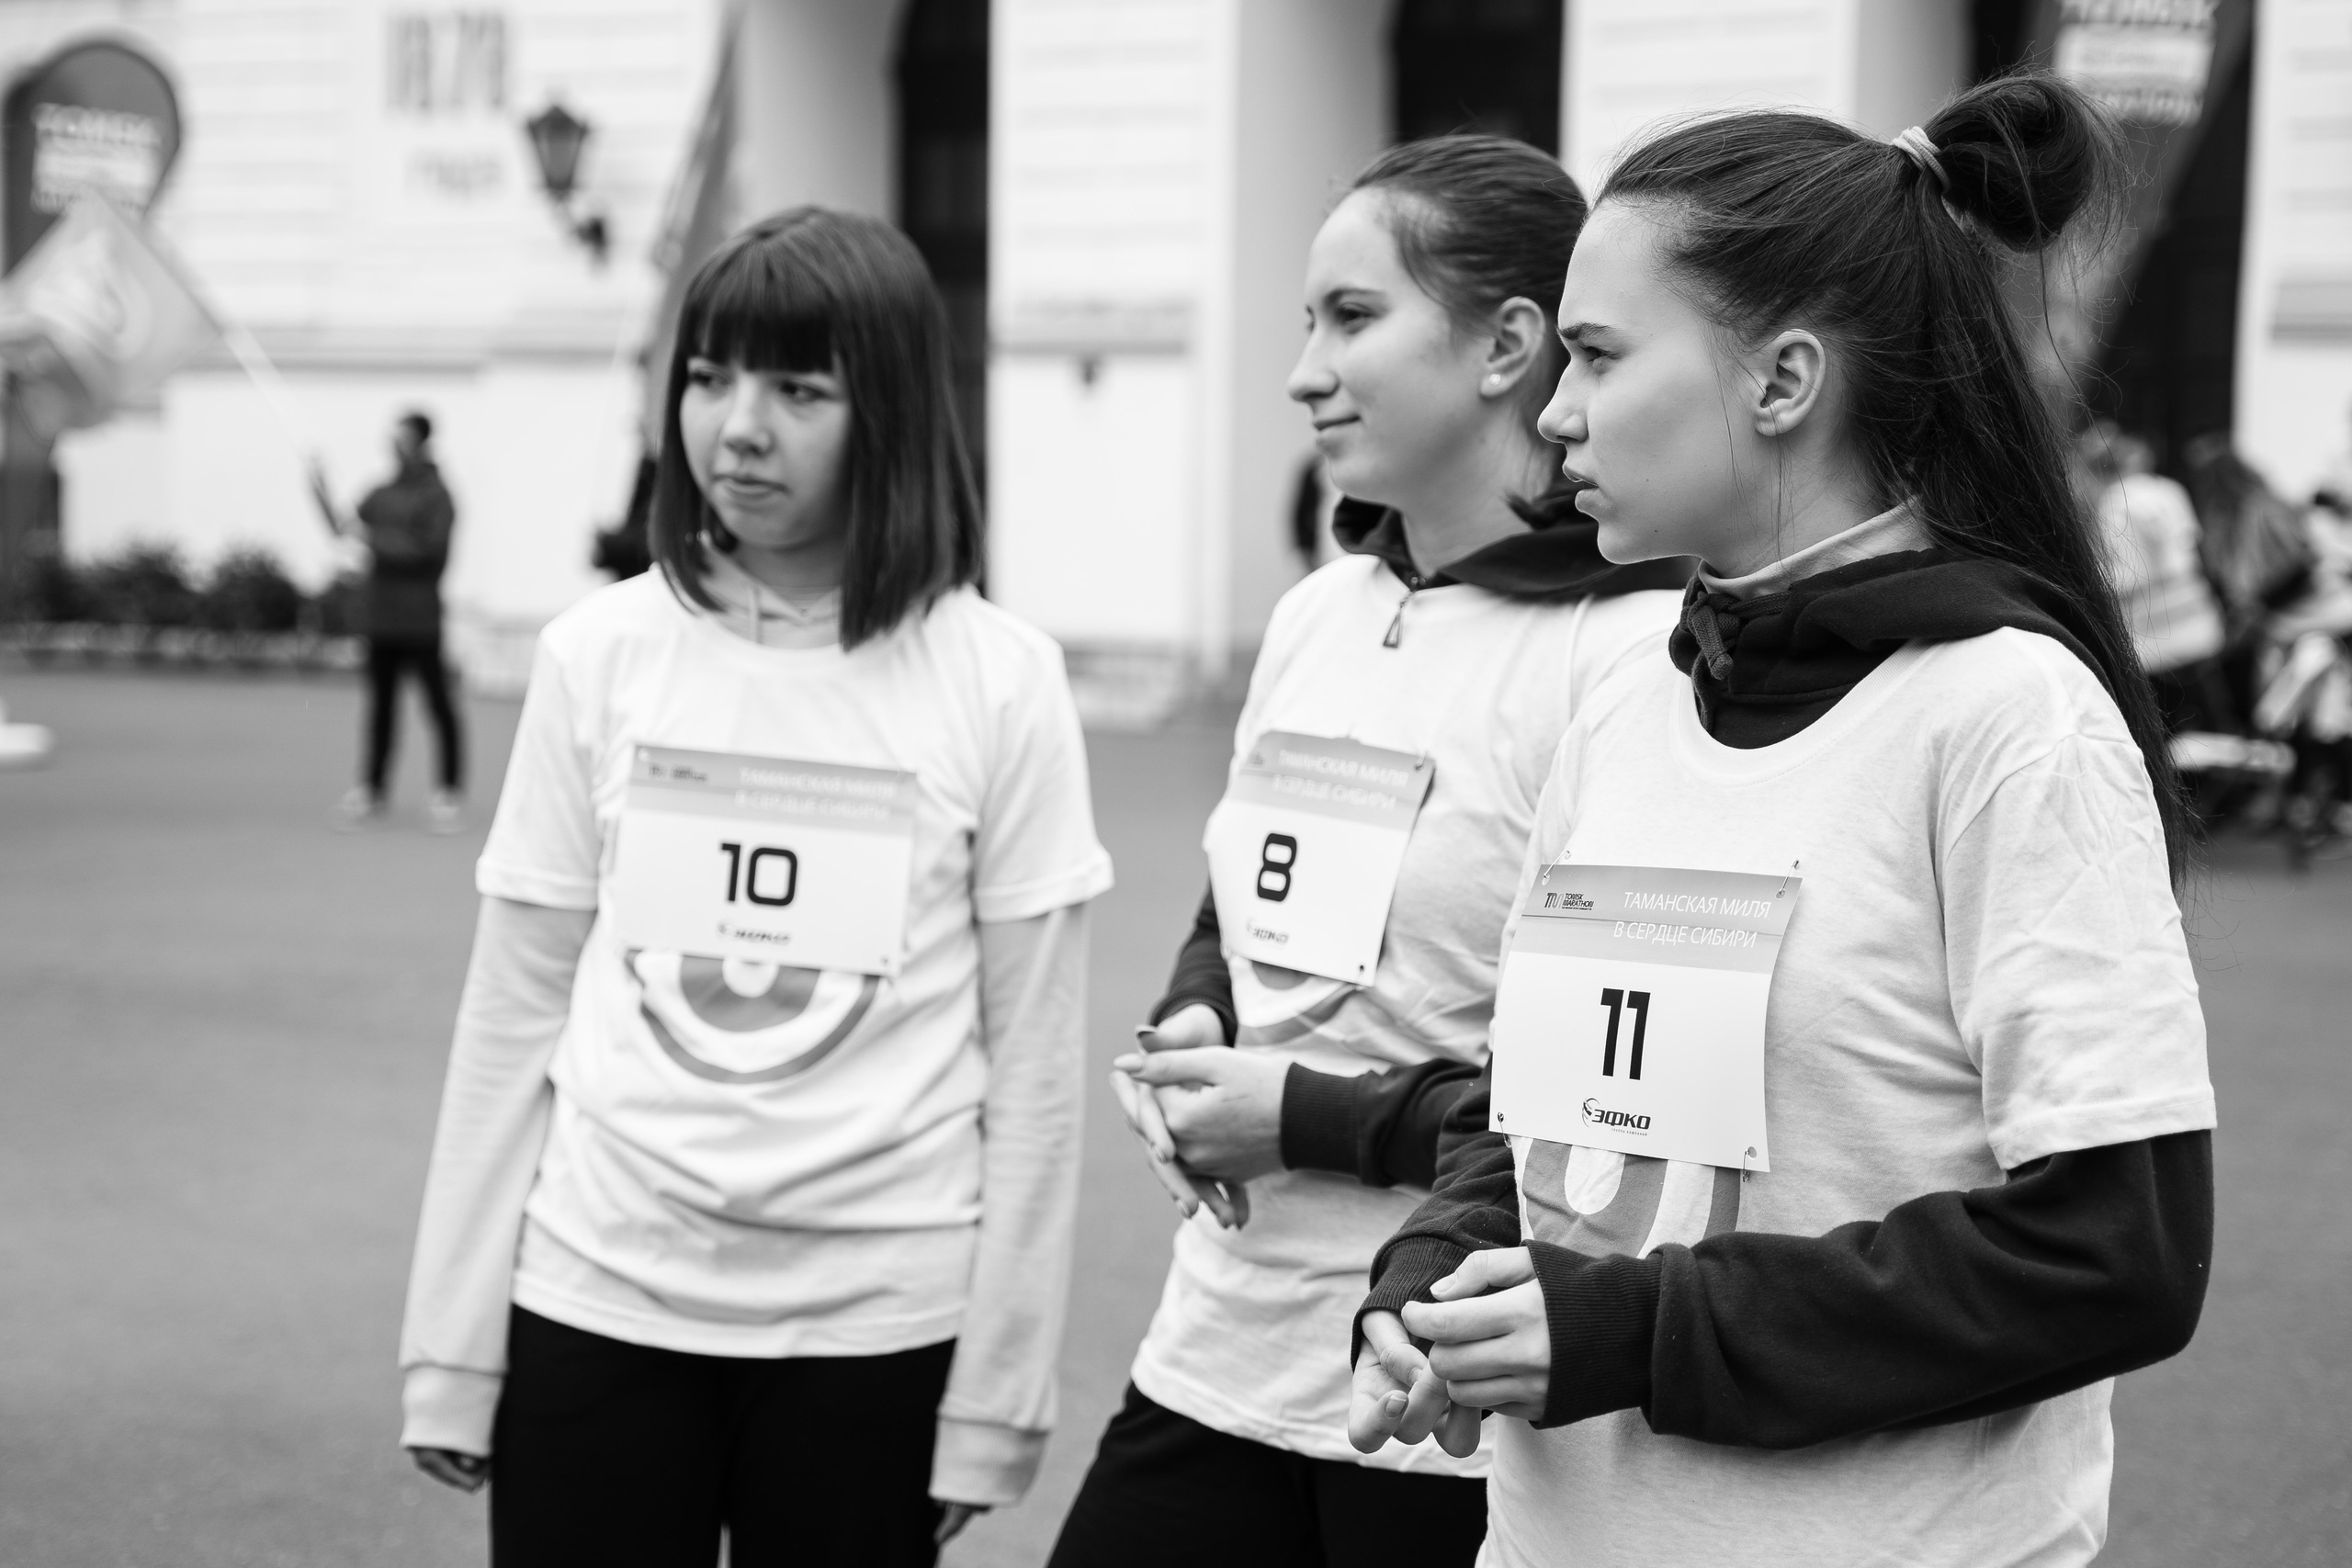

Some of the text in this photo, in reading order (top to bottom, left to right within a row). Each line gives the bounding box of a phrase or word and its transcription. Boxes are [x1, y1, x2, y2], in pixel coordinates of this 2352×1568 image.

[719, 841, 798, 907] 10
[1257, 832, 1297, 902] 8
[1562, 899, 1594, 908] MARATHON
[1623, 891, 1771, 919] ТАМАНСКАЯ МИЛЯ
[1613, 921, 1758, 948] В СЕРДЦЕ СИБИРИ
[1600, 987, 1651, 1081] 11
[1591, 1109, 1651, 1130] ЭФКО
